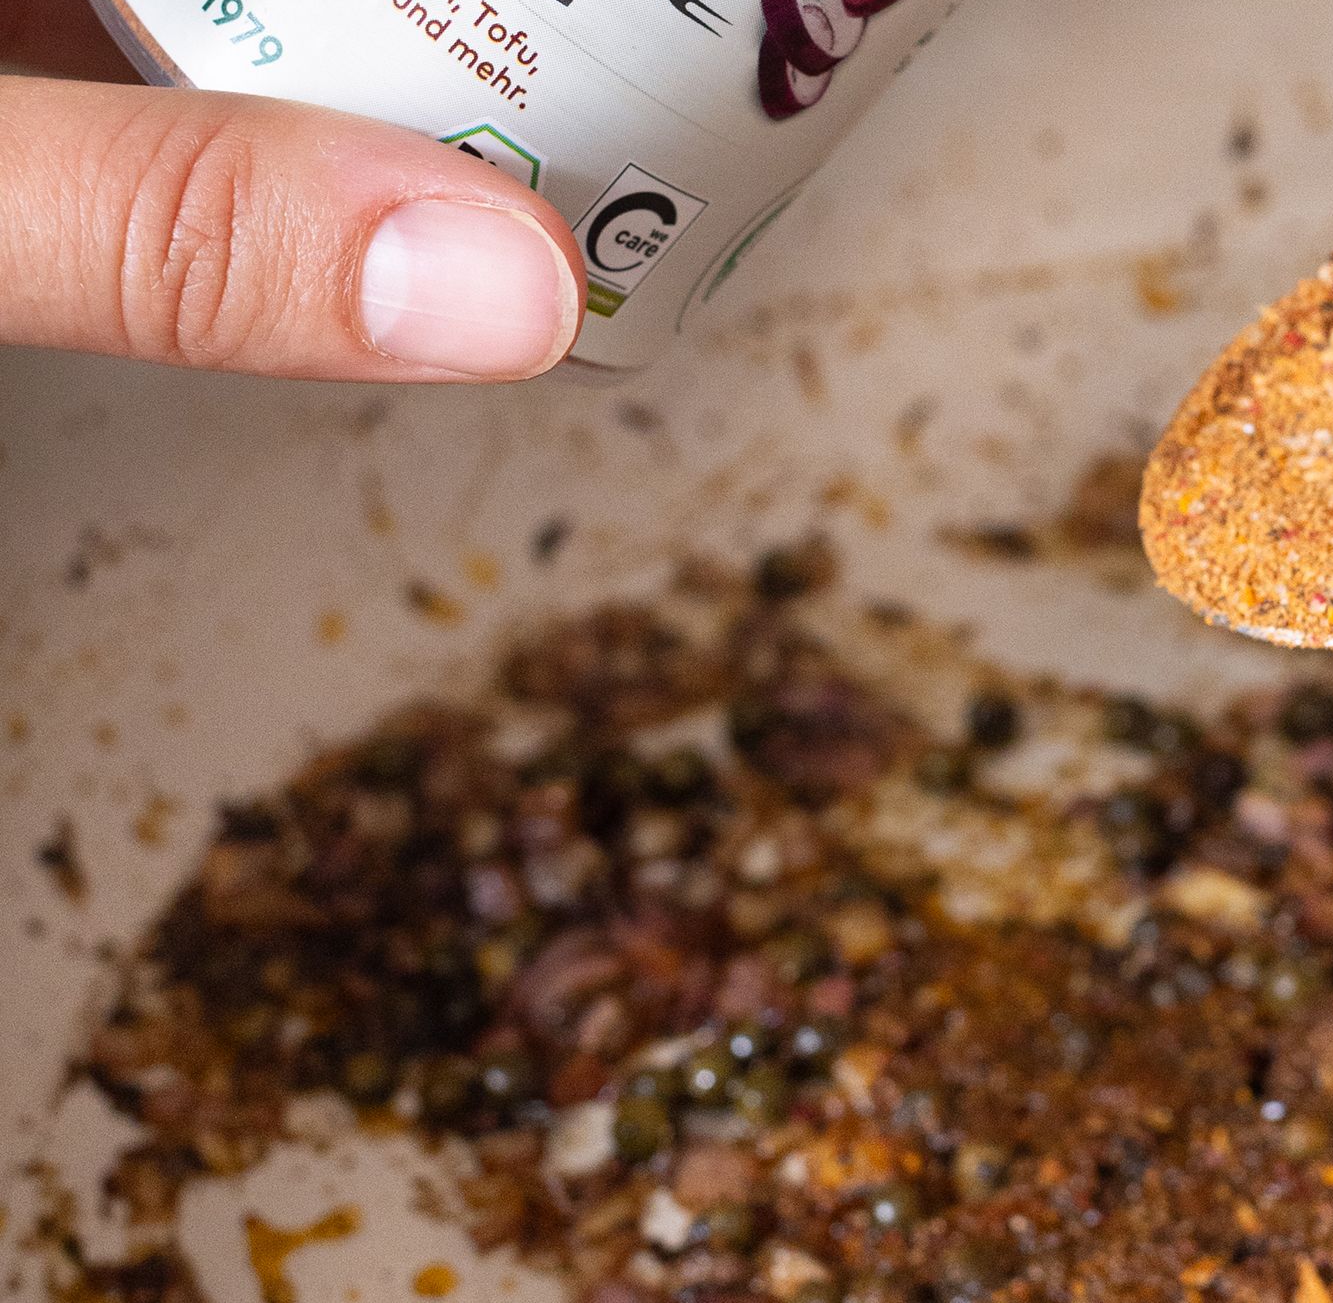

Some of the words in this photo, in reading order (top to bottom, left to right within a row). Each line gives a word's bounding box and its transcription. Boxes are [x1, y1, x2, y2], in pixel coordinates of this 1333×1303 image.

[472, 0, 539, 75] Tofu,
[447, 37, 527, 110] mehr.
[614, 228, 660, 258] care
[649, 226, 669, 243] we
